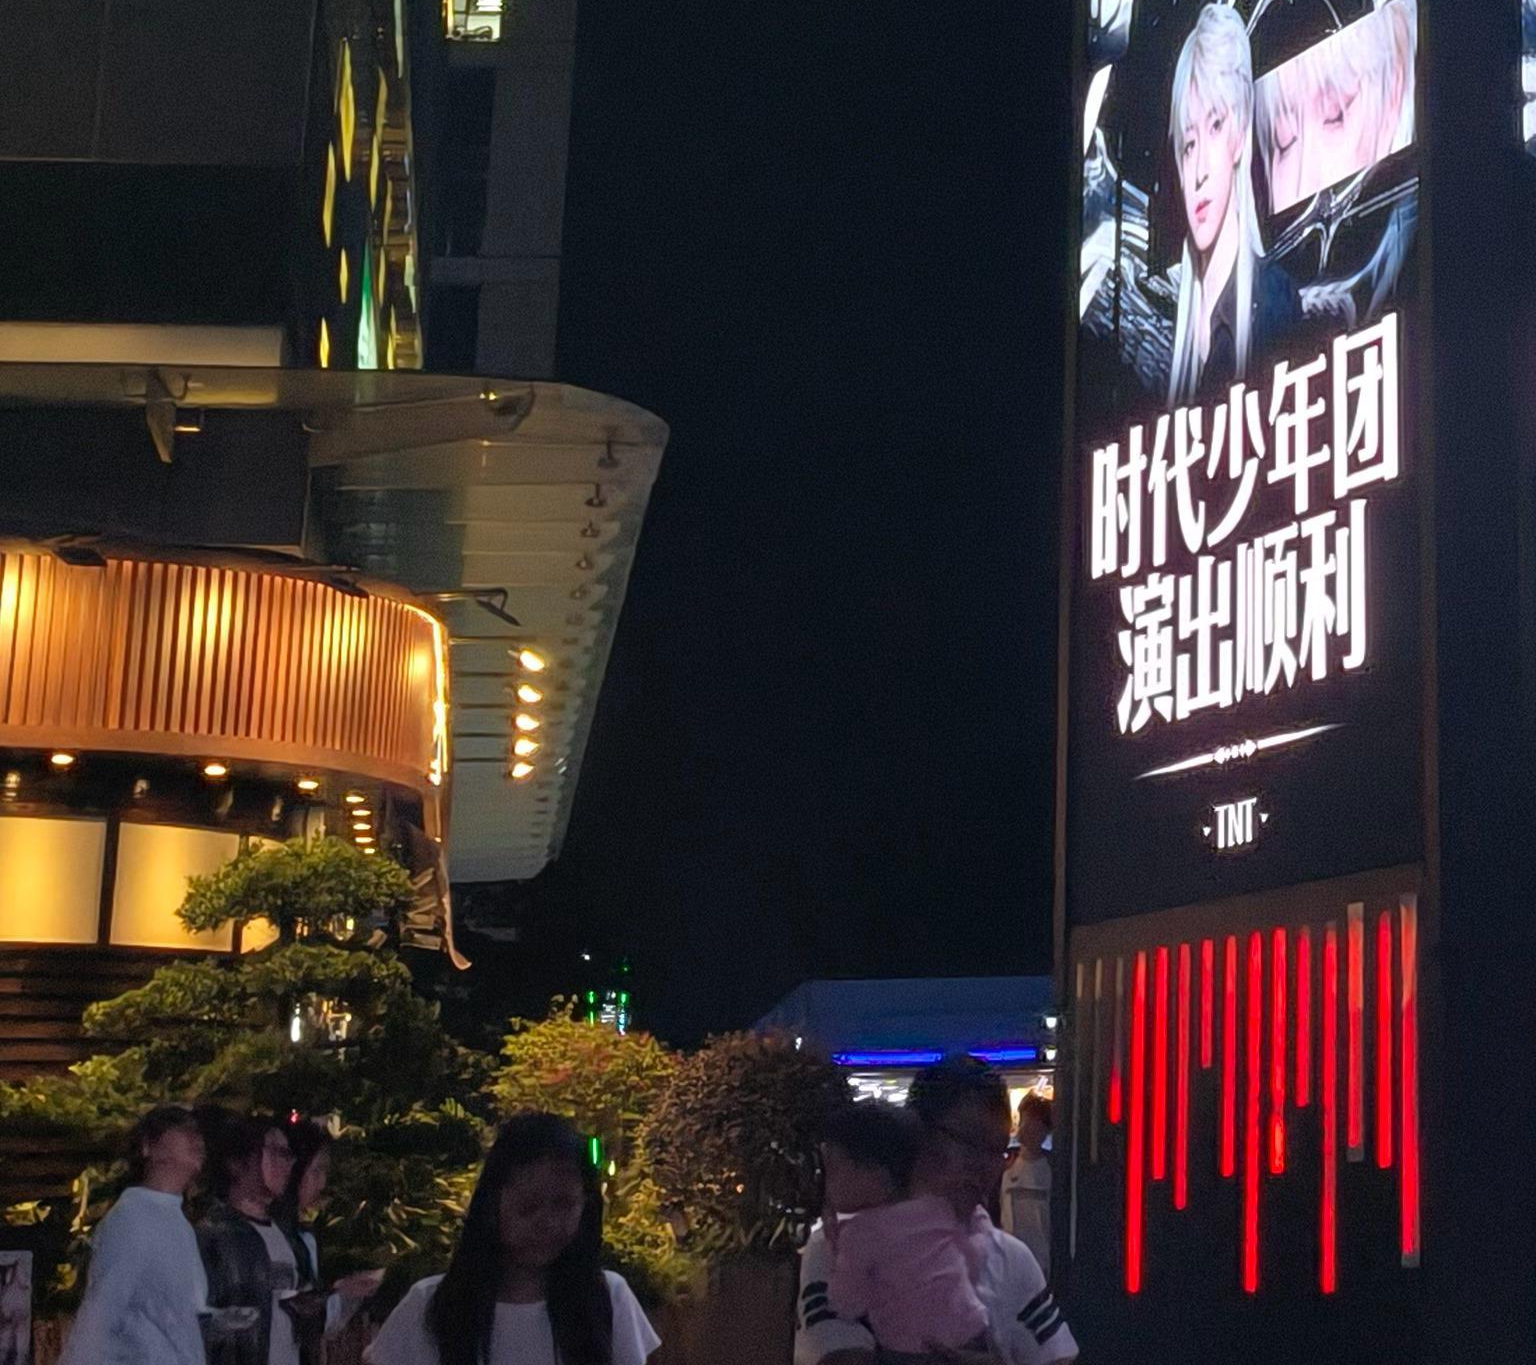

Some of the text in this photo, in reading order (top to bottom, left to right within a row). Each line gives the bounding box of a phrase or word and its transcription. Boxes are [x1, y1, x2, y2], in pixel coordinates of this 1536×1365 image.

[1091, 312, 1399, 579] 时代少年团
[1117, 499, 1367, 734] 演出顺利
[1213, 797, 1257, 849] TNT
